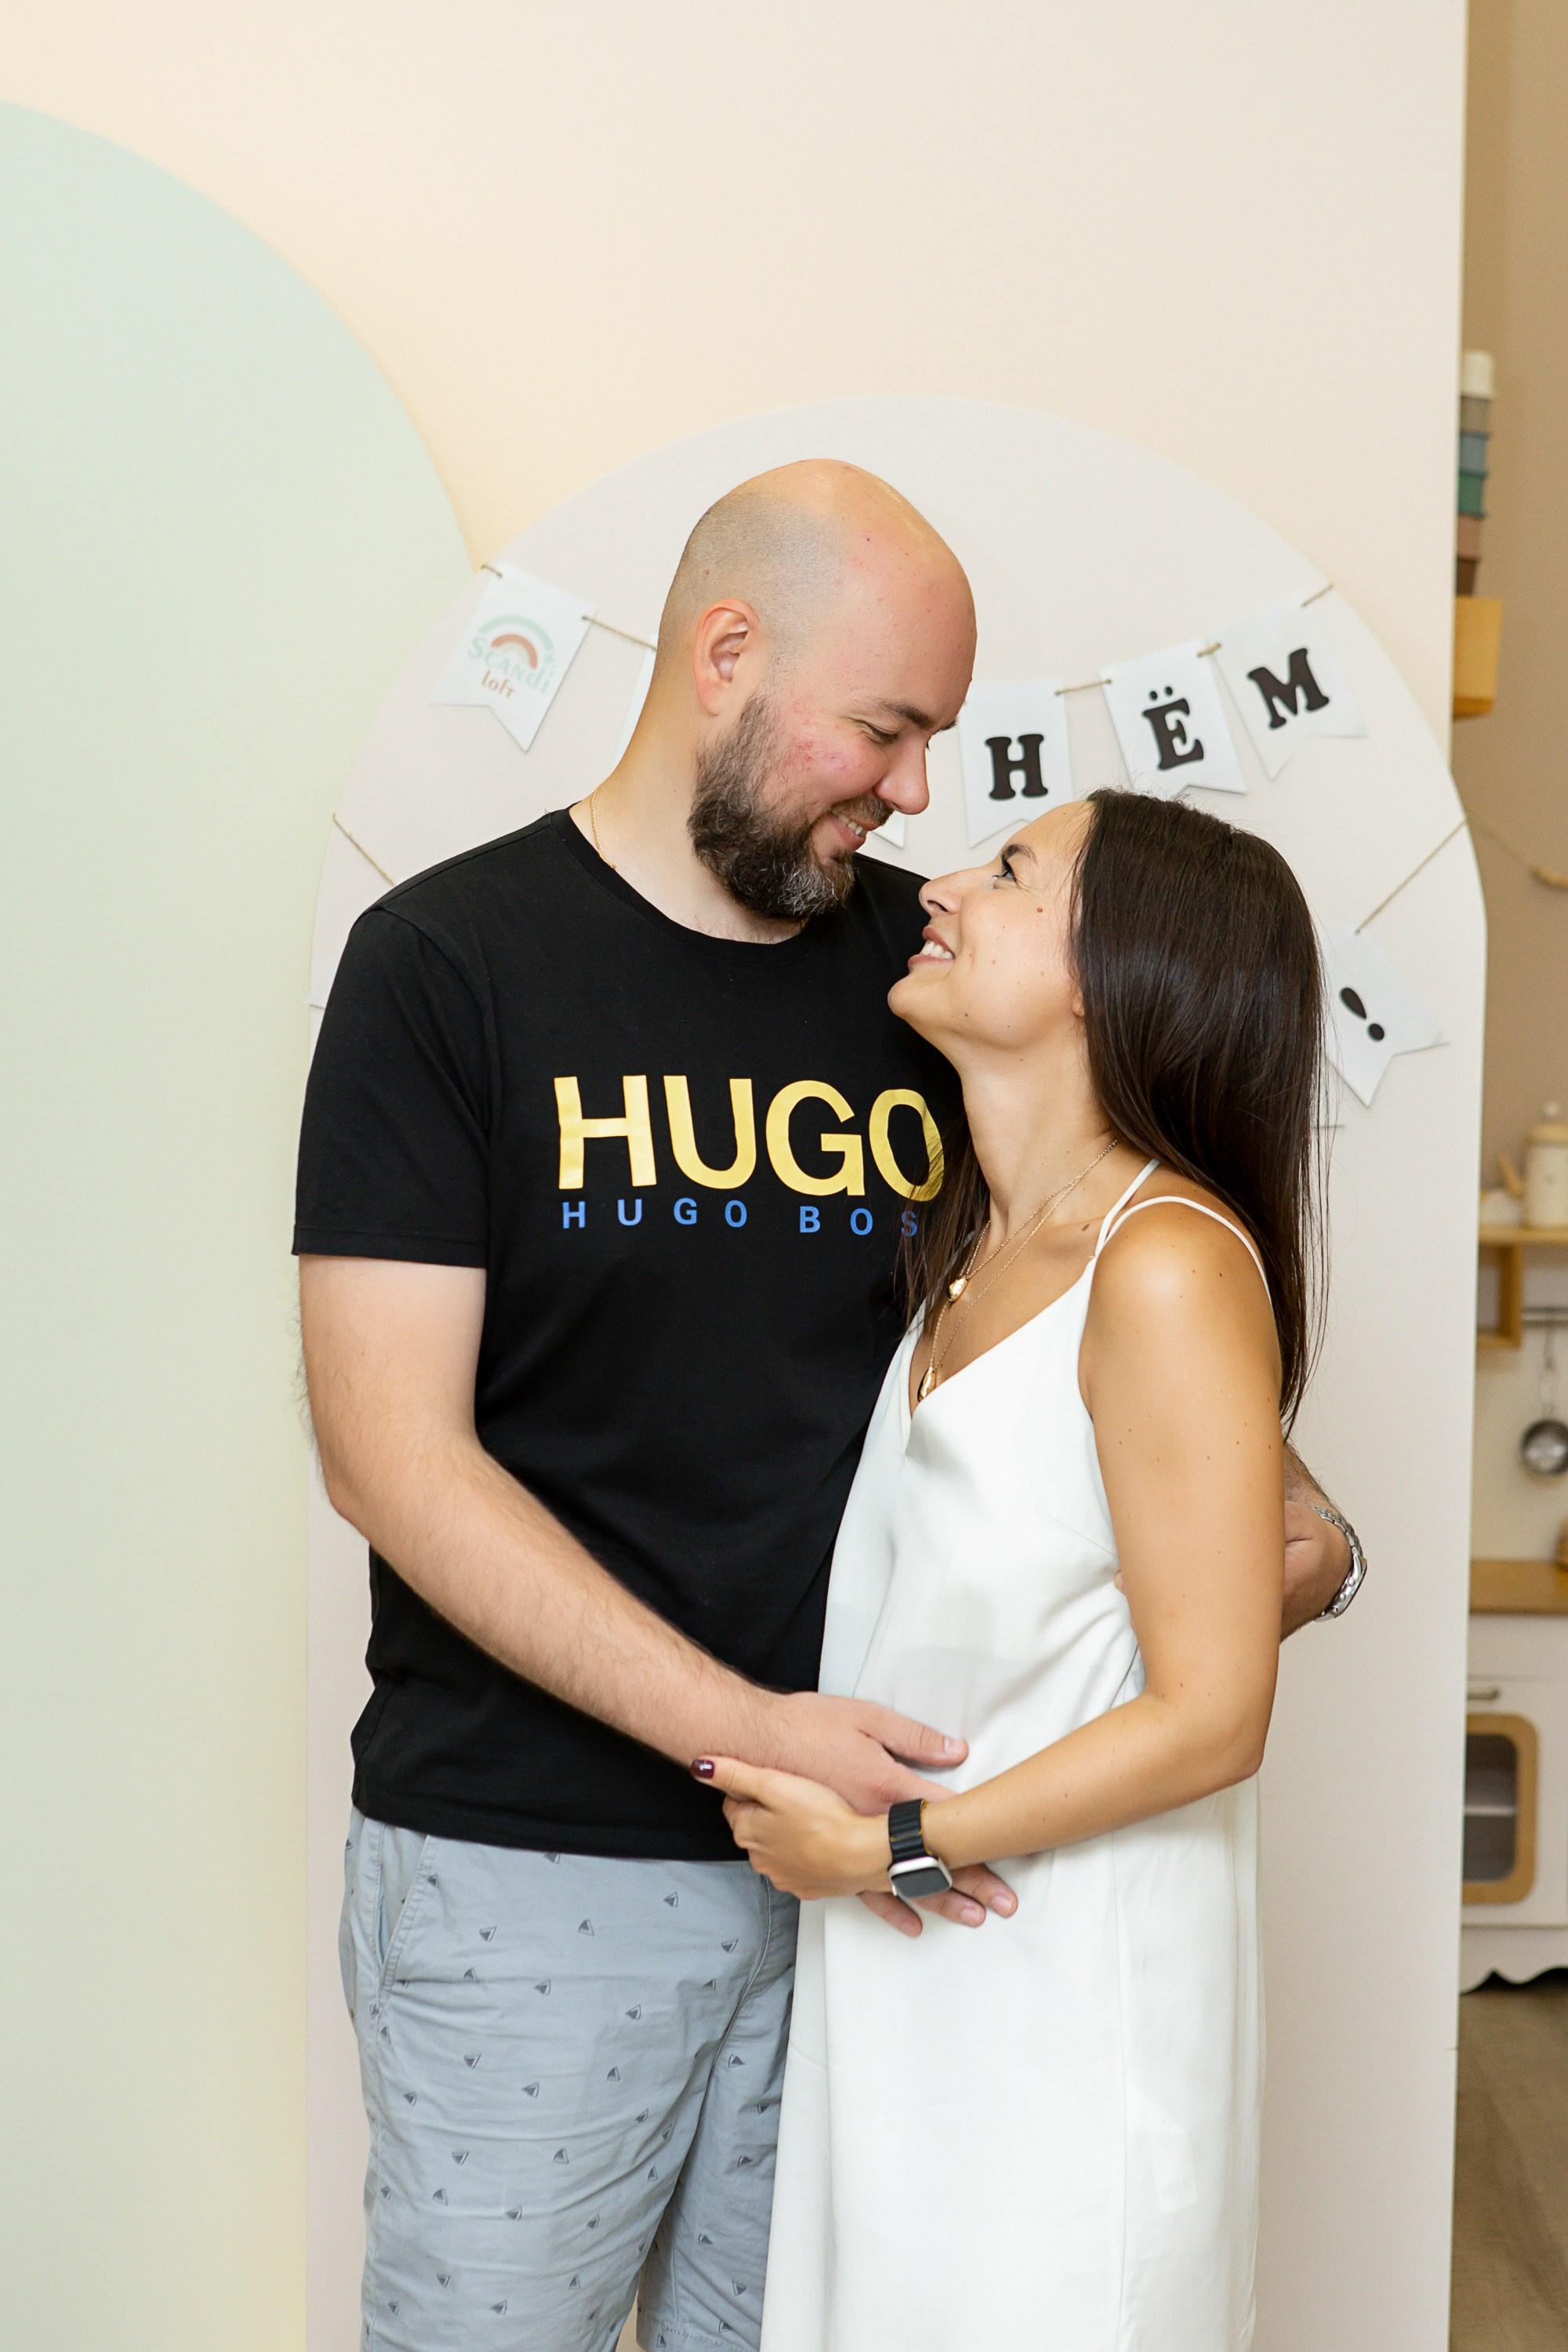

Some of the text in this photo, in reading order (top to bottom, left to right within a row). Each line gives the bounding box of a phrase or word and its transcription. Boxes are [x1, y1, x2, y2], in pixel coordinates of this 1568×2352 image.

[554, 1074, 945, 1202] HUGO
[562, 1197, 918, 1238] HUGO BOS
